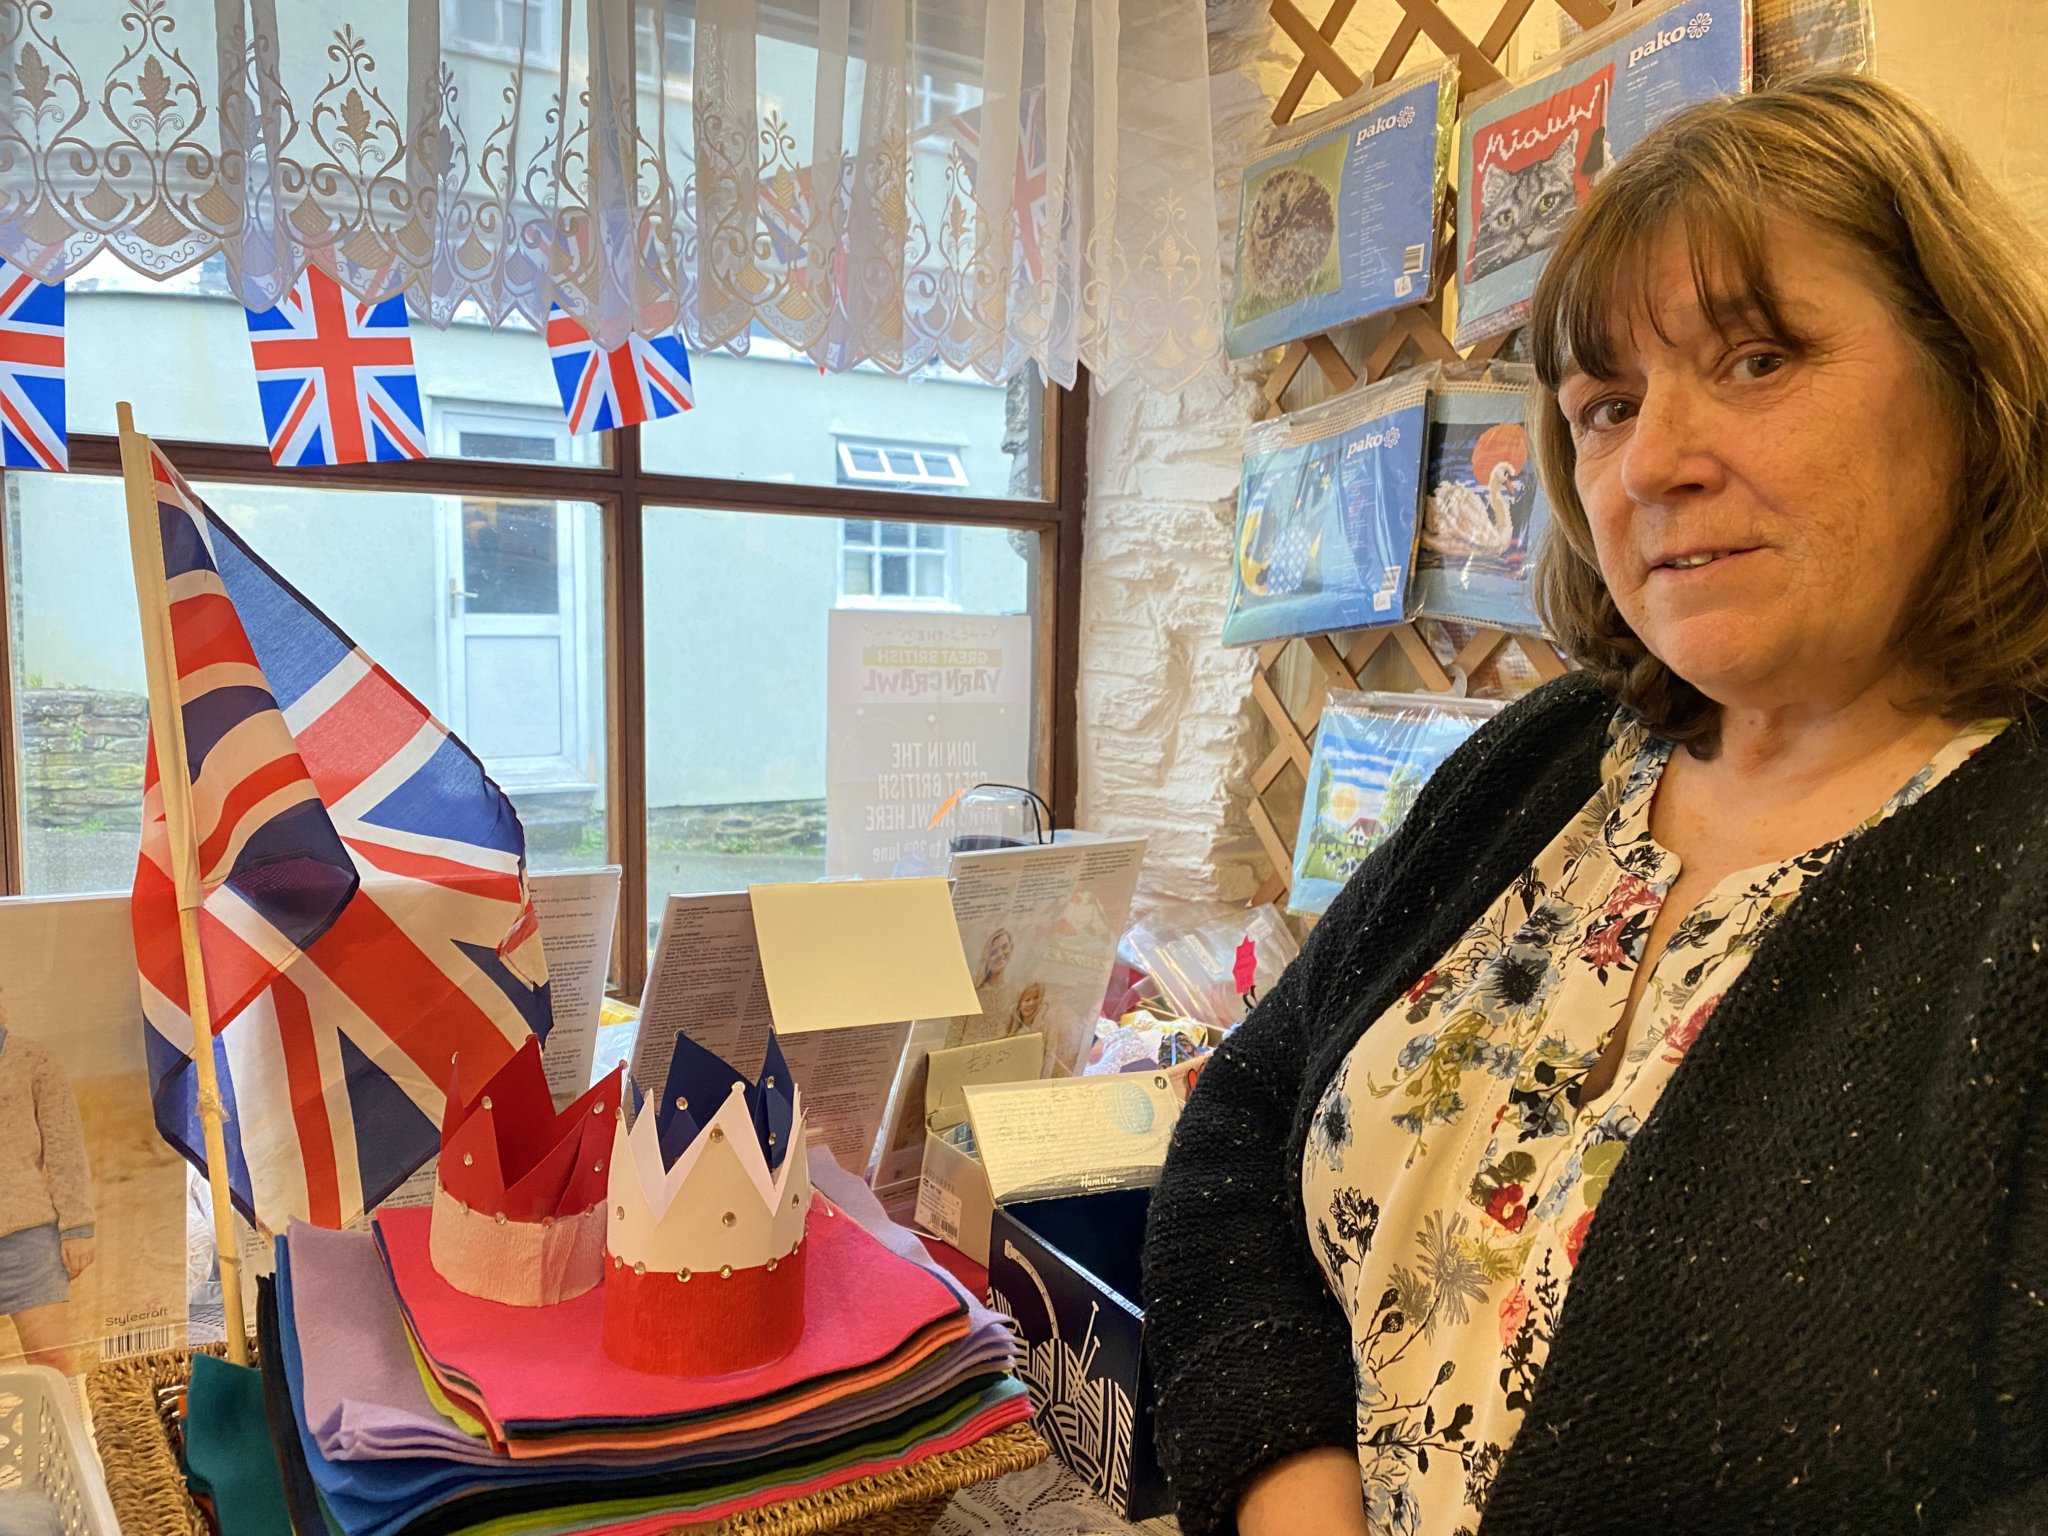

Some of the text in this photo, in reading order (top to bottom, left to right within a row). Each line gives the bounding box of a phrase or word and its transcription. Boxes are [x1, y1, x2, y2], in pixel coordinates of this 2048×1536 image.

[1627, 25, 1686, 69] pako
[1355, 115, 1397, 147] pako
[1346, 432, 1383, 459] pako
[1080, 1173, 1123, 1188] Hemline
[105, 1307, 168, 1327] Stylecraft
